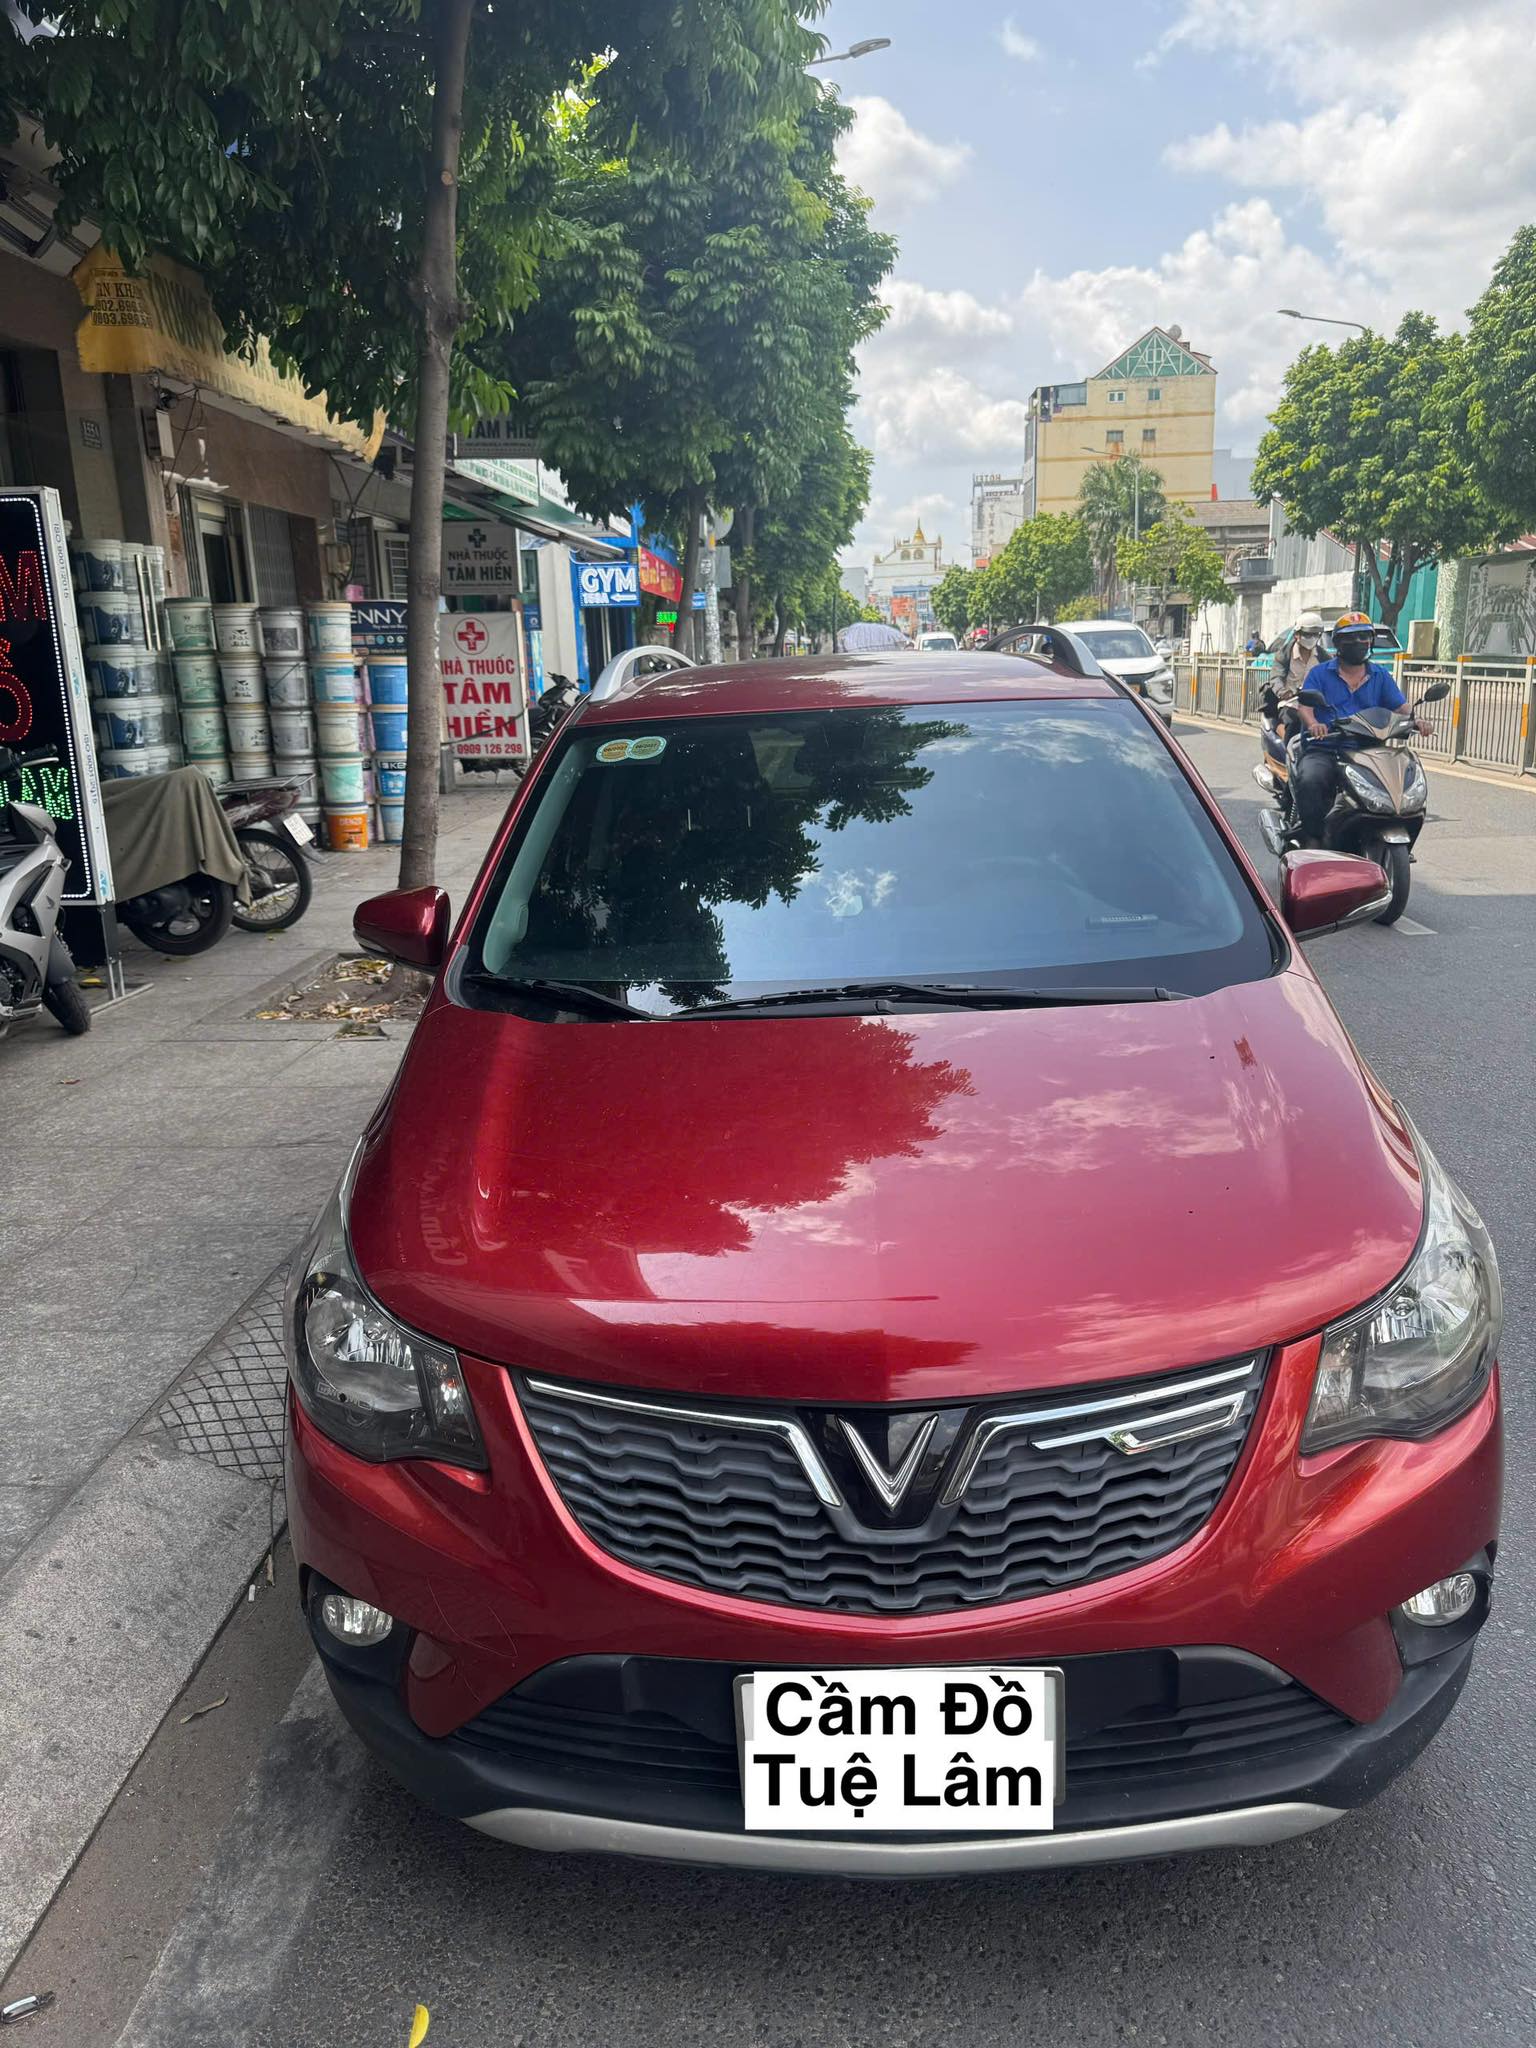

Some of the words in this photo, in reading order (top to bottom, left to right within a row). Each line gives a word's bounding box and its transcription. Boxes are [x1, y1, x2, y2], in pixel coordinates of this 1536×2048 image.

[448, 548, 470, 560] NHÀ
[472, 547, 509, 560] THUỐC
[448, 563, 476, 581] TÂM
[581, 567, 637, 593] GYM
[351, 608, 408, 624] ENNY
[468, 653, 515, 675] THUỐC
[443, 677, 512, 704] TÂM
[447, 709, 518, 738] HIỀN
[457, 744, 481, 754] 0909
[485, 744, 501, 754] 126
[505, 744, 523, 754] 298
